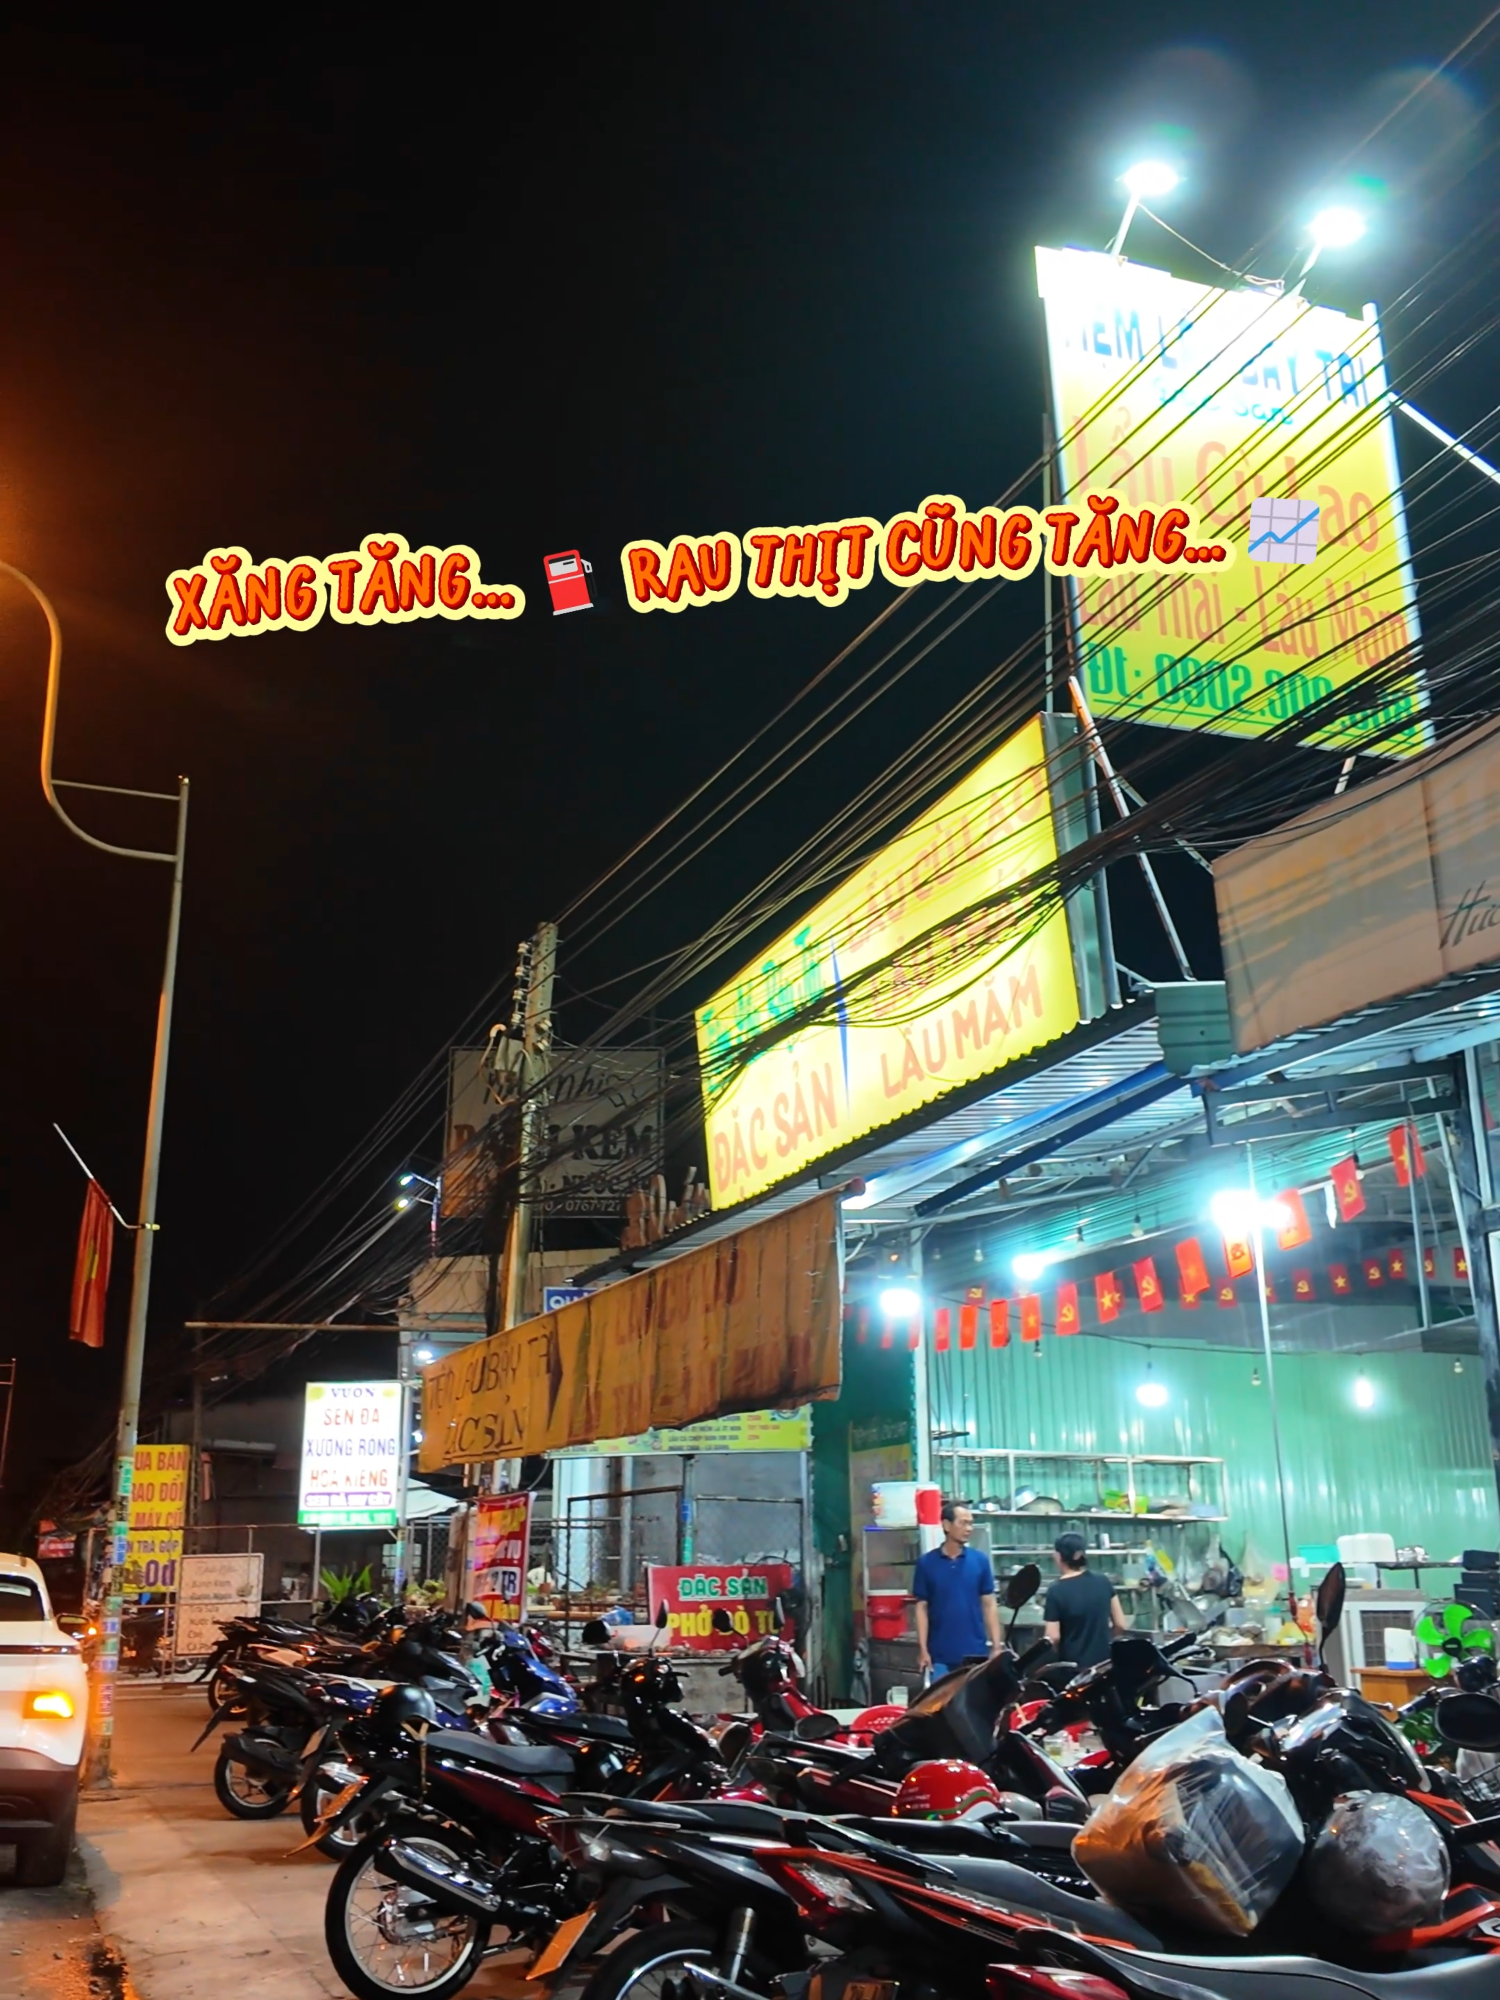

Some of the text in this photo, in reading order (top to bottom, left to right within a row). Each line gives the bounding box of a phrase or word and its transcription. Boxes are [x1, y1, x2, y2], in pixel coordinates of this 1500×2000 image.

[961, 765, 1043, 864] LAO
[880, 964, 1044, 1099] LẨU MẮM
[713, 1060, 838, 1200] ĐẶC SẢN
[323, 1408, 354, 1426] SEN
[134, 1447, 187, 1472] UA BÁN
[132, 1482, 155, 1503] RAO
[726, 1569, 768, 1598] SẢN
[667, 1604, 713, 1637] PHỞ
